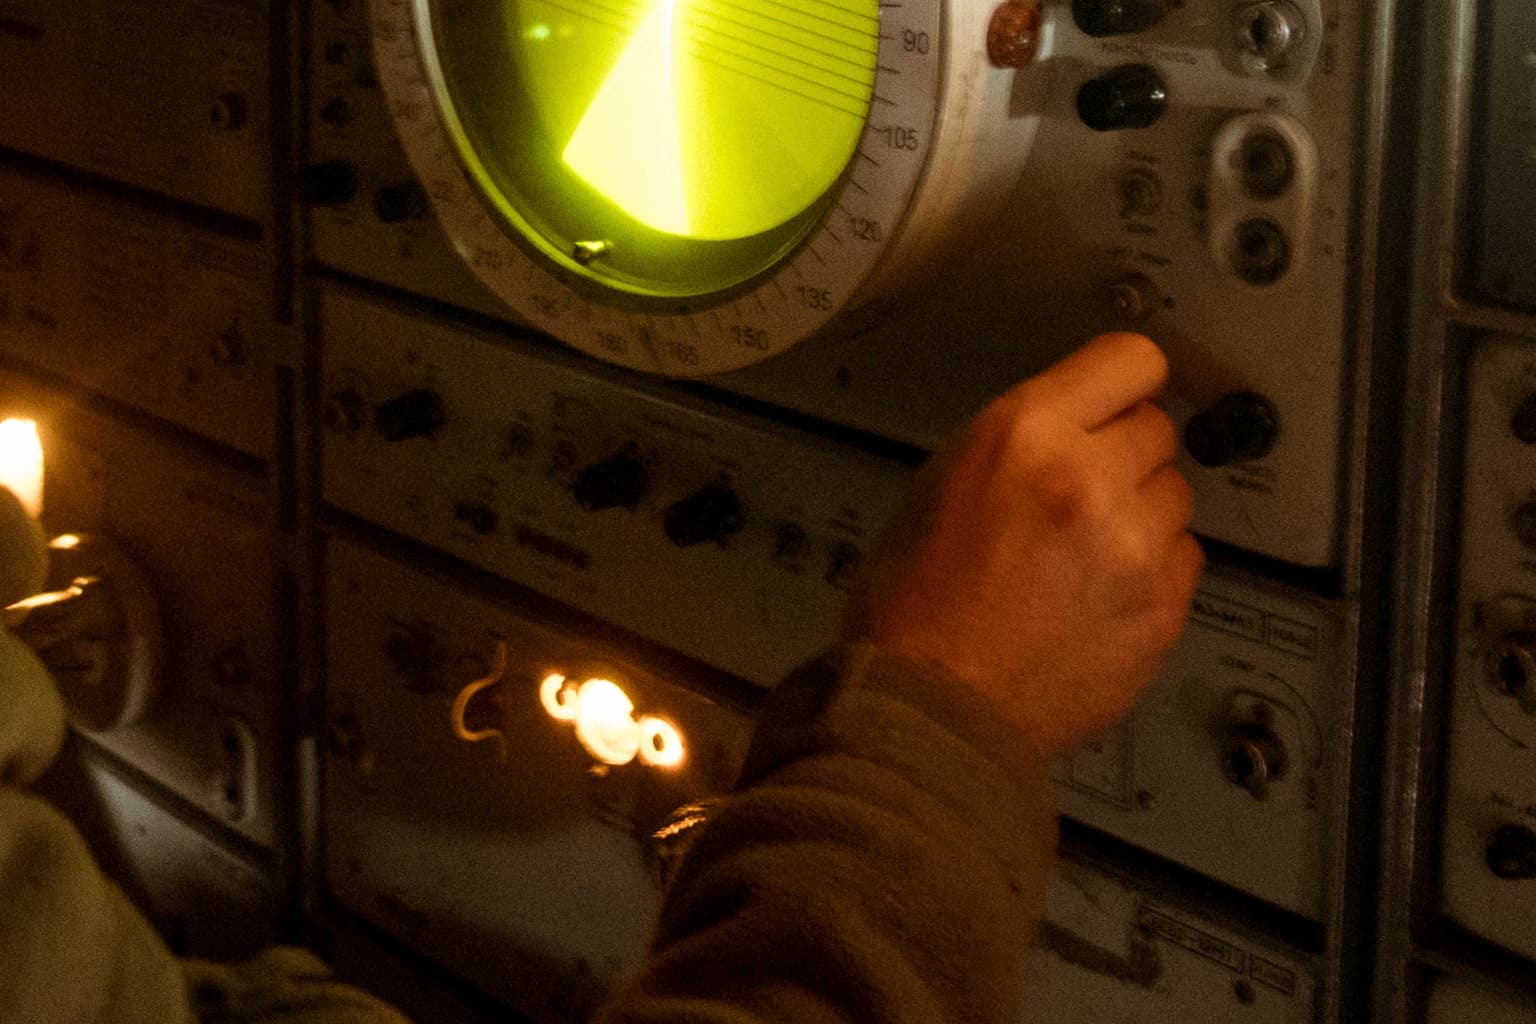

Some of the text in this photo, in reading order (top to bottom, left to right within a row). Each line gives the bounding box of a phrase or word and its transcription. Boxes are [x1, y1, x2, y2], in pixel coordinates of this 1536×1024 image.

[903, 29, 929, 55] 90
[884, 128, 918, 151] 105
[798, 286, 833, 311] 135
[732, 325, 769, 351] 150
